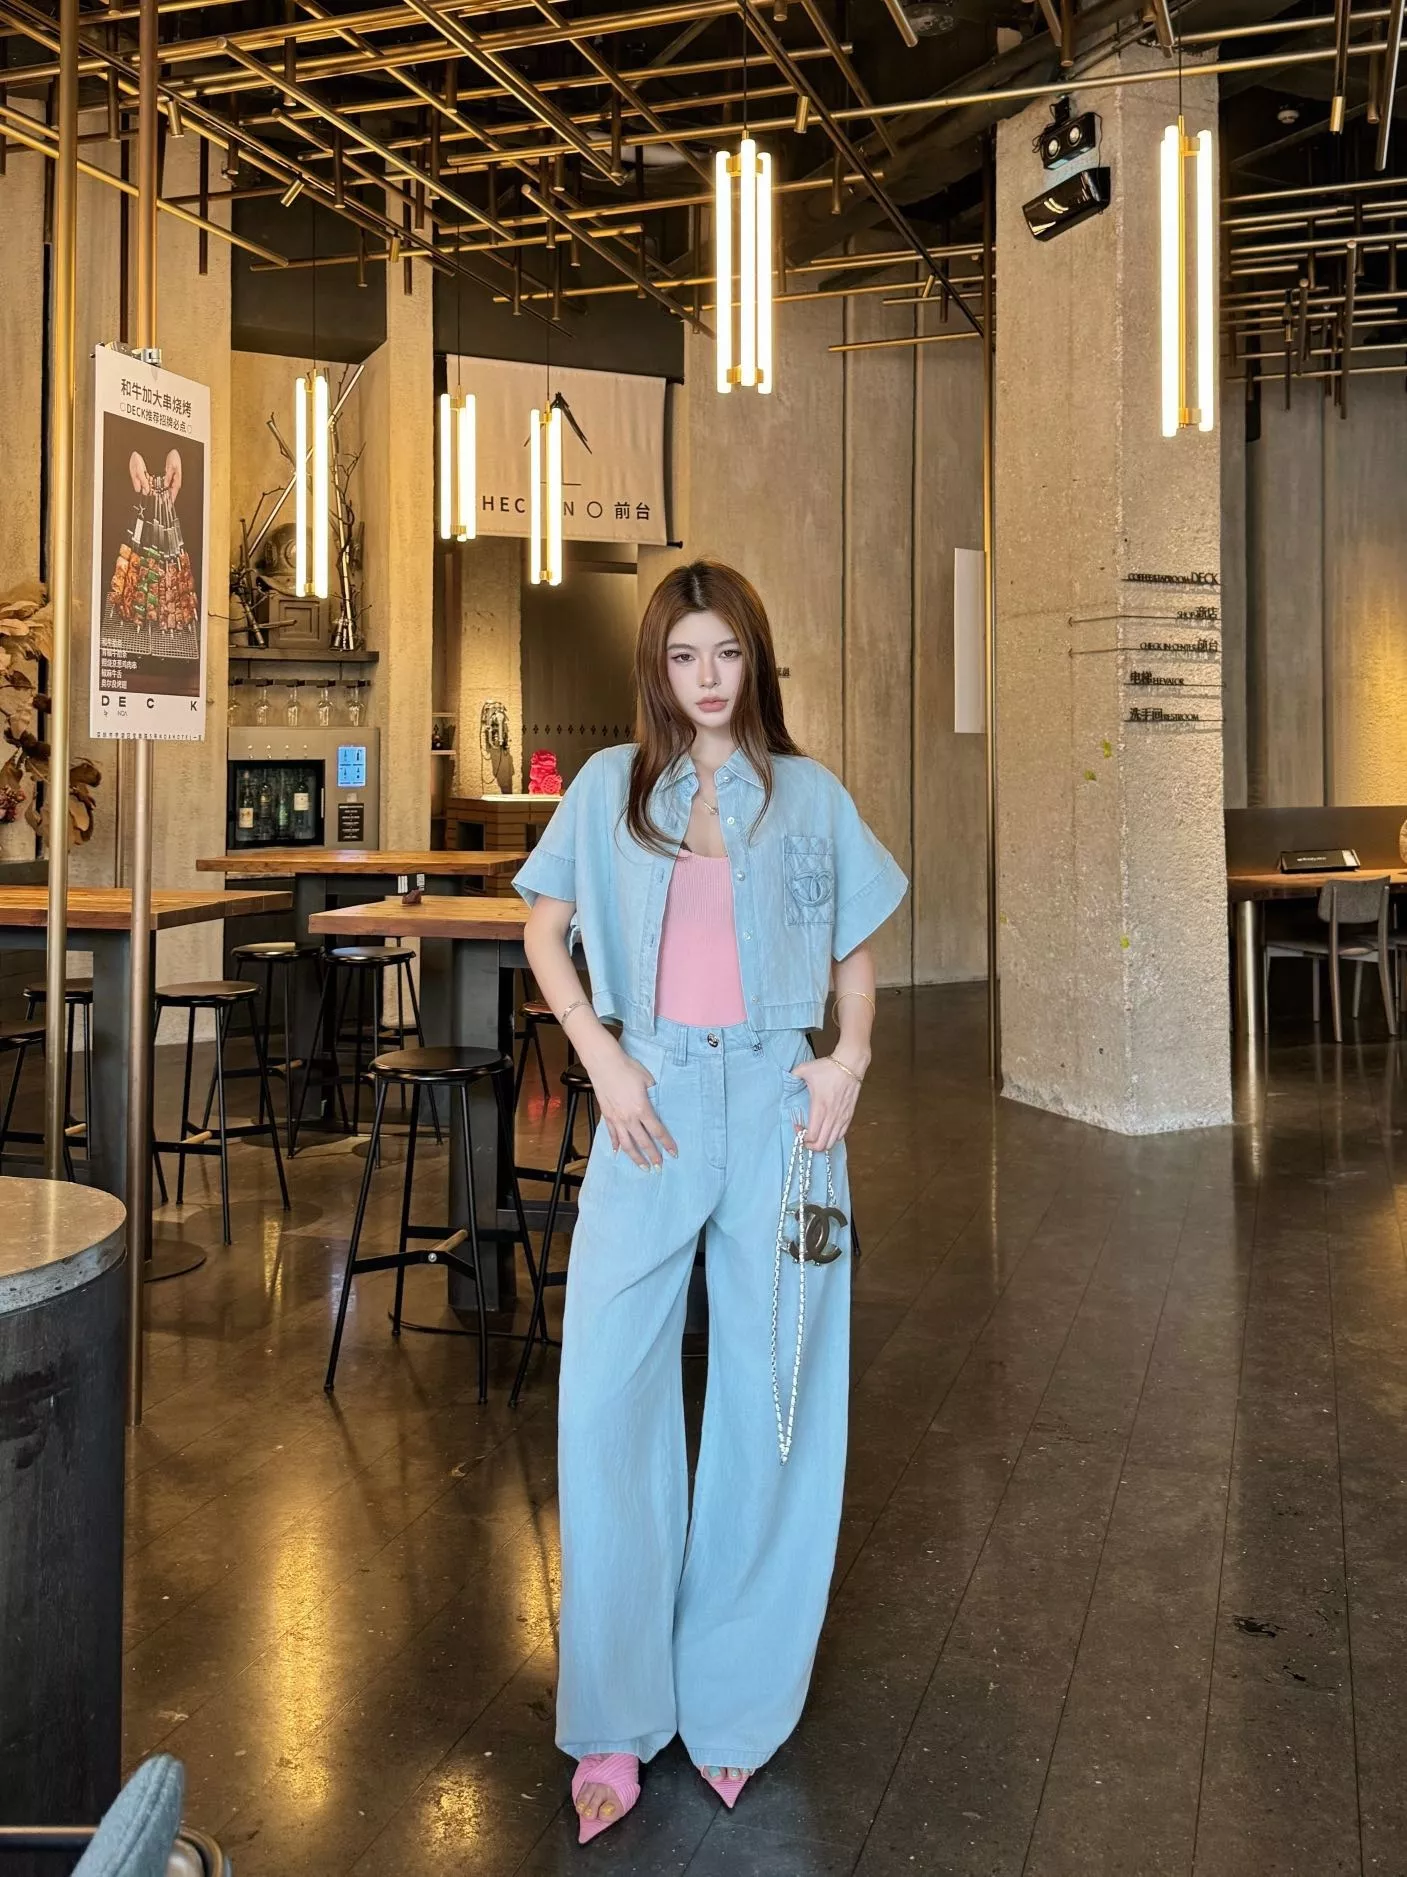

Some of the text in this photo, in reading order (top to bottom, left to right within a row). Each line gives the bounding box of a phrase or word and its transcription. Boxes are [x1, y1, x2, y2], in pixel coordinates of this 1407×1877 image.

[120, 378, 192, 418] 和牛加大串烧烤
[614, 501, 651, 521] 前台
